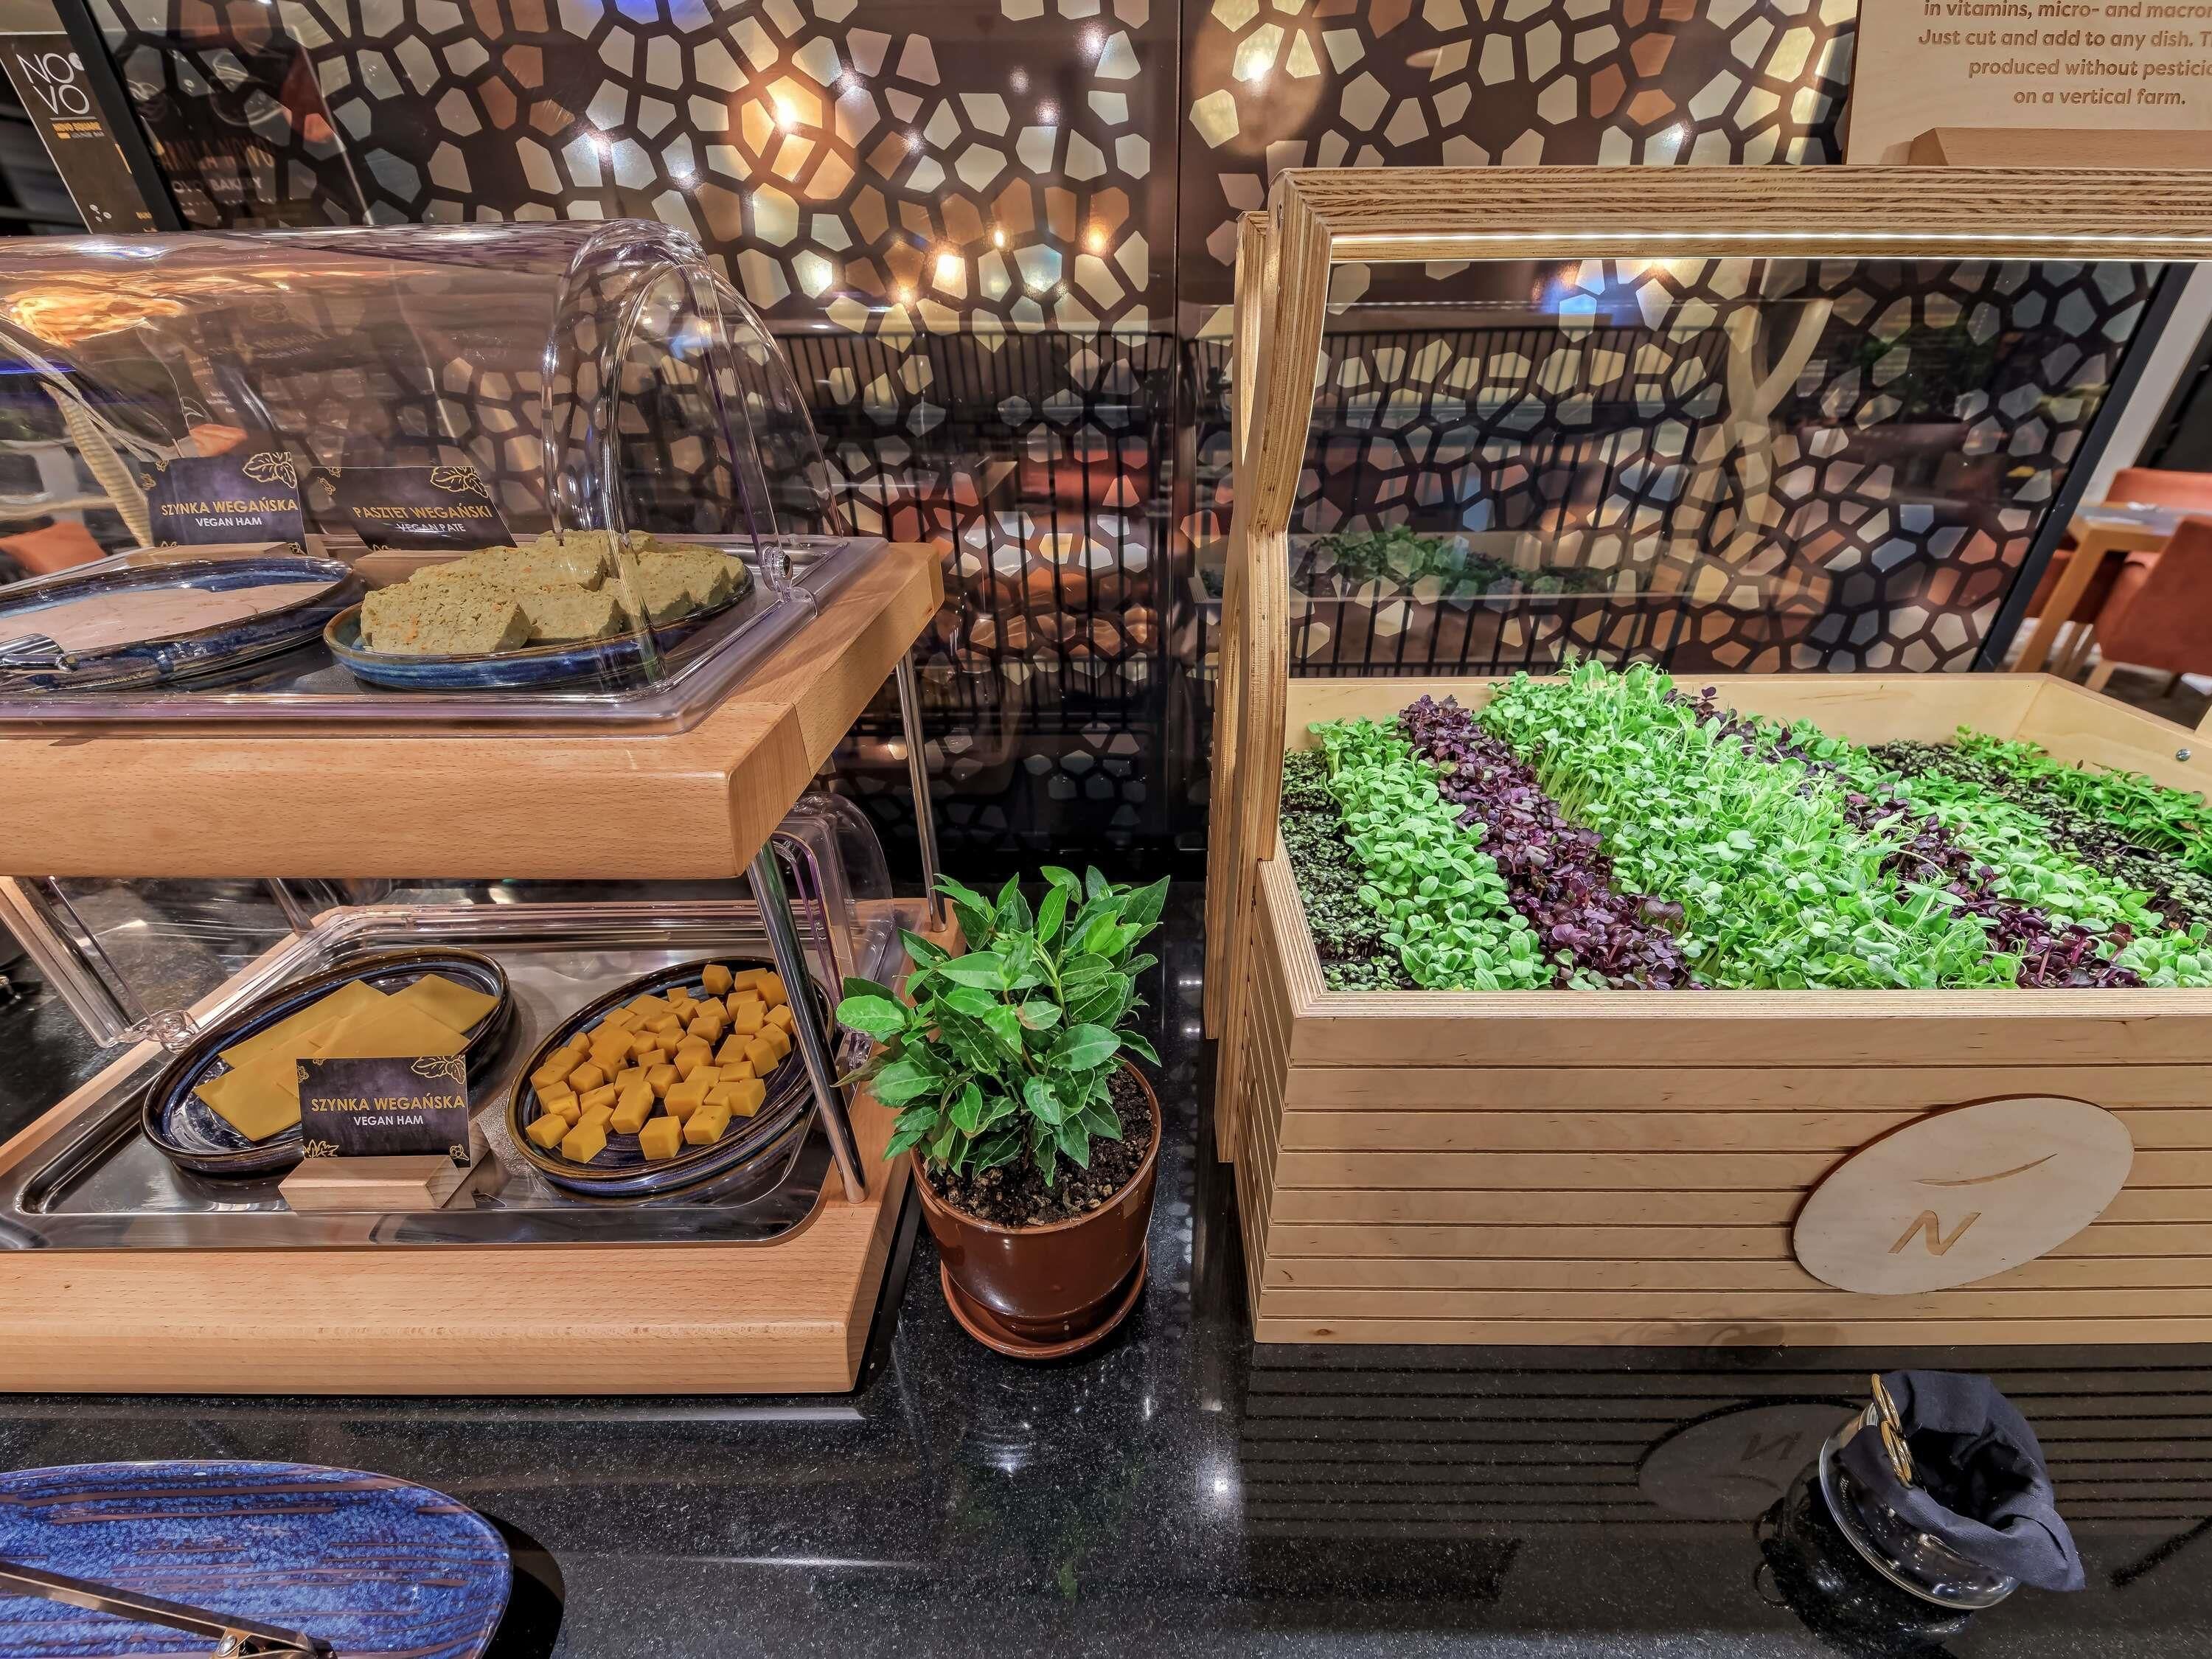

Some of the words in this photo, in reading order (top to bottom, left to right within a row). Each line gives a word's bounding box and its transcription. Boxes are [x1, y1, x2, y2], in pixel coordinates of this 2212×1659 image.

[1924, 0, 1941, 16] in
[1947, 0, 2033, 19] vitamins,
[2038, 1, 2099, 17] micro-
[2105, 2, 2141, 18] and
[1919, 29, 1961, 45] Just
[1965, 31, 1996, 46] cut
[2001, 29, 2037, 46] and
[2042, 30, 2081, 46] add
[2085, 32, 2105, 46] to
[2110, 34, 2146, 51] any
[2151, 31, 2194, 47] dish.
[2199, 31, 2212, 47] T
[1969, 58, 2059, 78] produced
[2065, 59, 2138, 76] without
[2014, 91, 2037, 103] on
[2042, 91, 2053, 103] a
[2059, 88, 2132, 105] vertical
[2138, 88, 2186, 105] farm.
[161, 501, 210, 516] SZYNKA
[212, 497, 299, 513] WEGAŃSKA
[352, 507, 409, 518] PASZTET
[410, 502, 493, 518] WEGAŃSKI
[195, 518, 234, 527] VEGAN
[236, 517, 262, 526] HAM
[396, 523, 438, 532] VEGAN
[439, 524, 467, 532] PATE
[311, 1097, 370, 1112] SZYNKA
[374, 1092, 465, 1110] WEGAŃSKA
[353, 1116, 394, 1126] VEGAN
[397, 1115, 424, 1125] HAM
[1887, 1209, 1982, 1256] N
